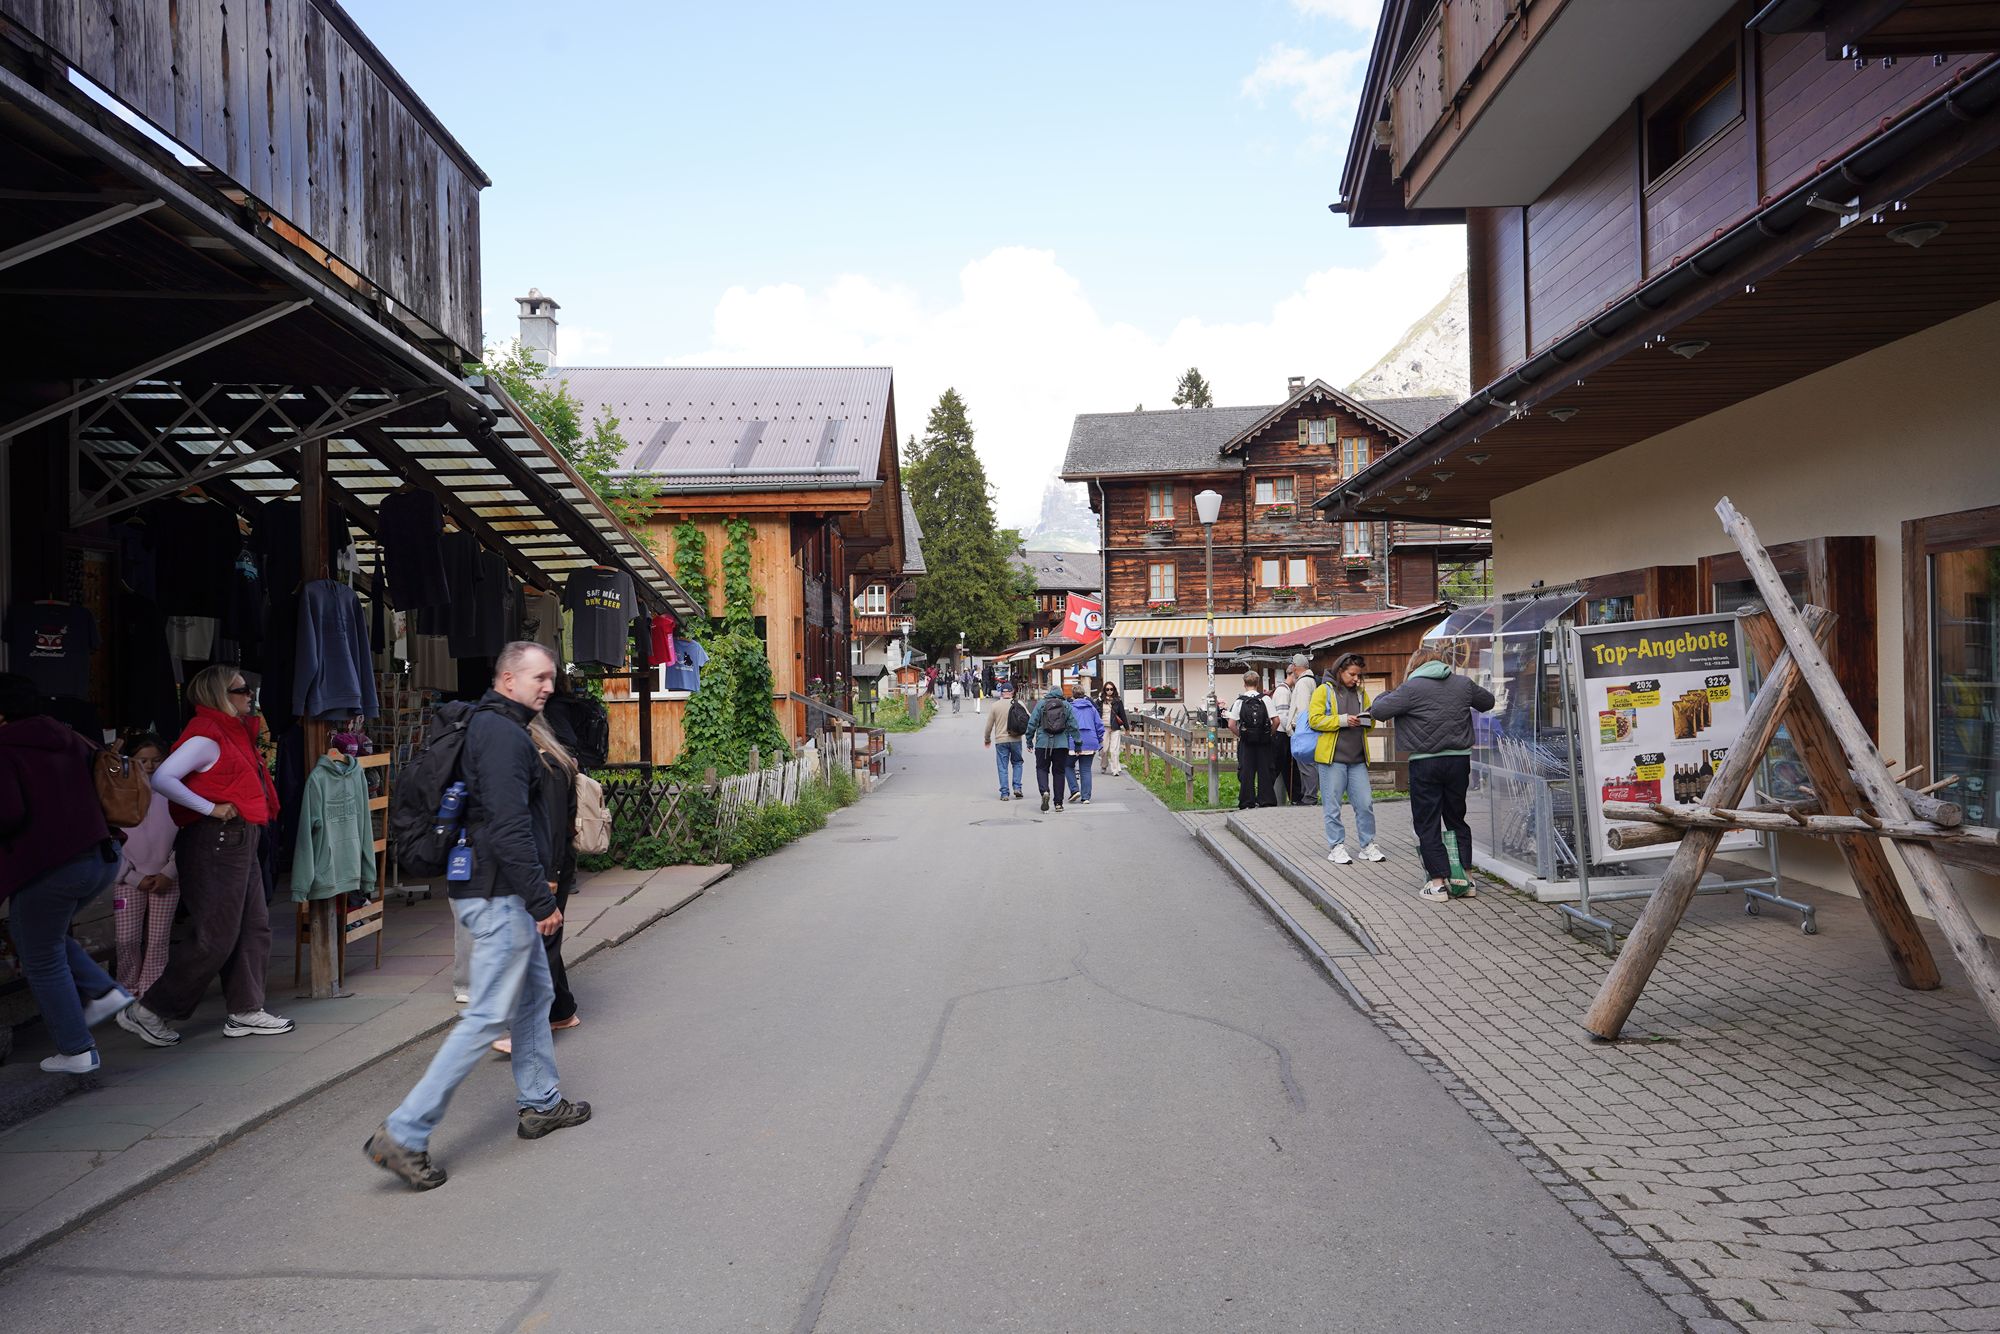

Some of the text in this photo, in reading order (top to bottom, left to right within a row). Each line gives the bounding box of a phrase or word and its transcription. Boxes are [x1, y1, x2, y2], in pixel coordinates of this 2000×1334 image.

[602, 588, 621, 600] MILK
[603, 599, 621, 609] BEER
[1592, 631, 1729, 666] Top-Angebote
[1636, 680, 1653, 689] 20%
[1707, 676, 1727, 687] 32%
[1709, 689, 1729, 697] 25.95
[1641, 753, 1658, 763] 30%
